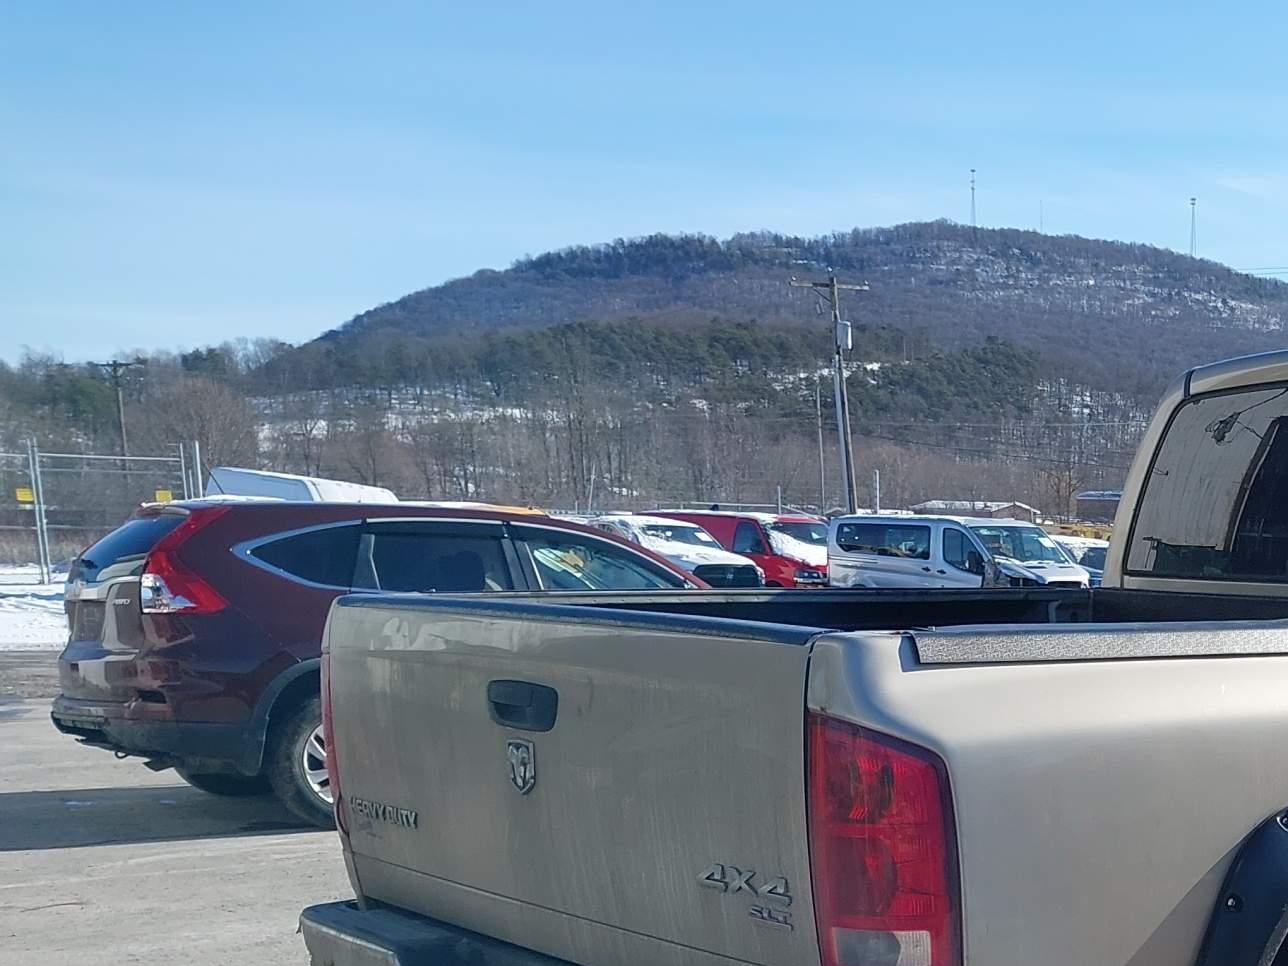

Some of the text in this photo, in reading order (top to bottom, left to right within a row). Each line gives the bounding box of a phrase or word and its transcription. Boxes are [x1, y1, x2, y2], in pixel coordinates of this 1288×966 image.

[349, 796, 419, 830] HEAVY DUTY
[748, 904, 794, 932] SLT
